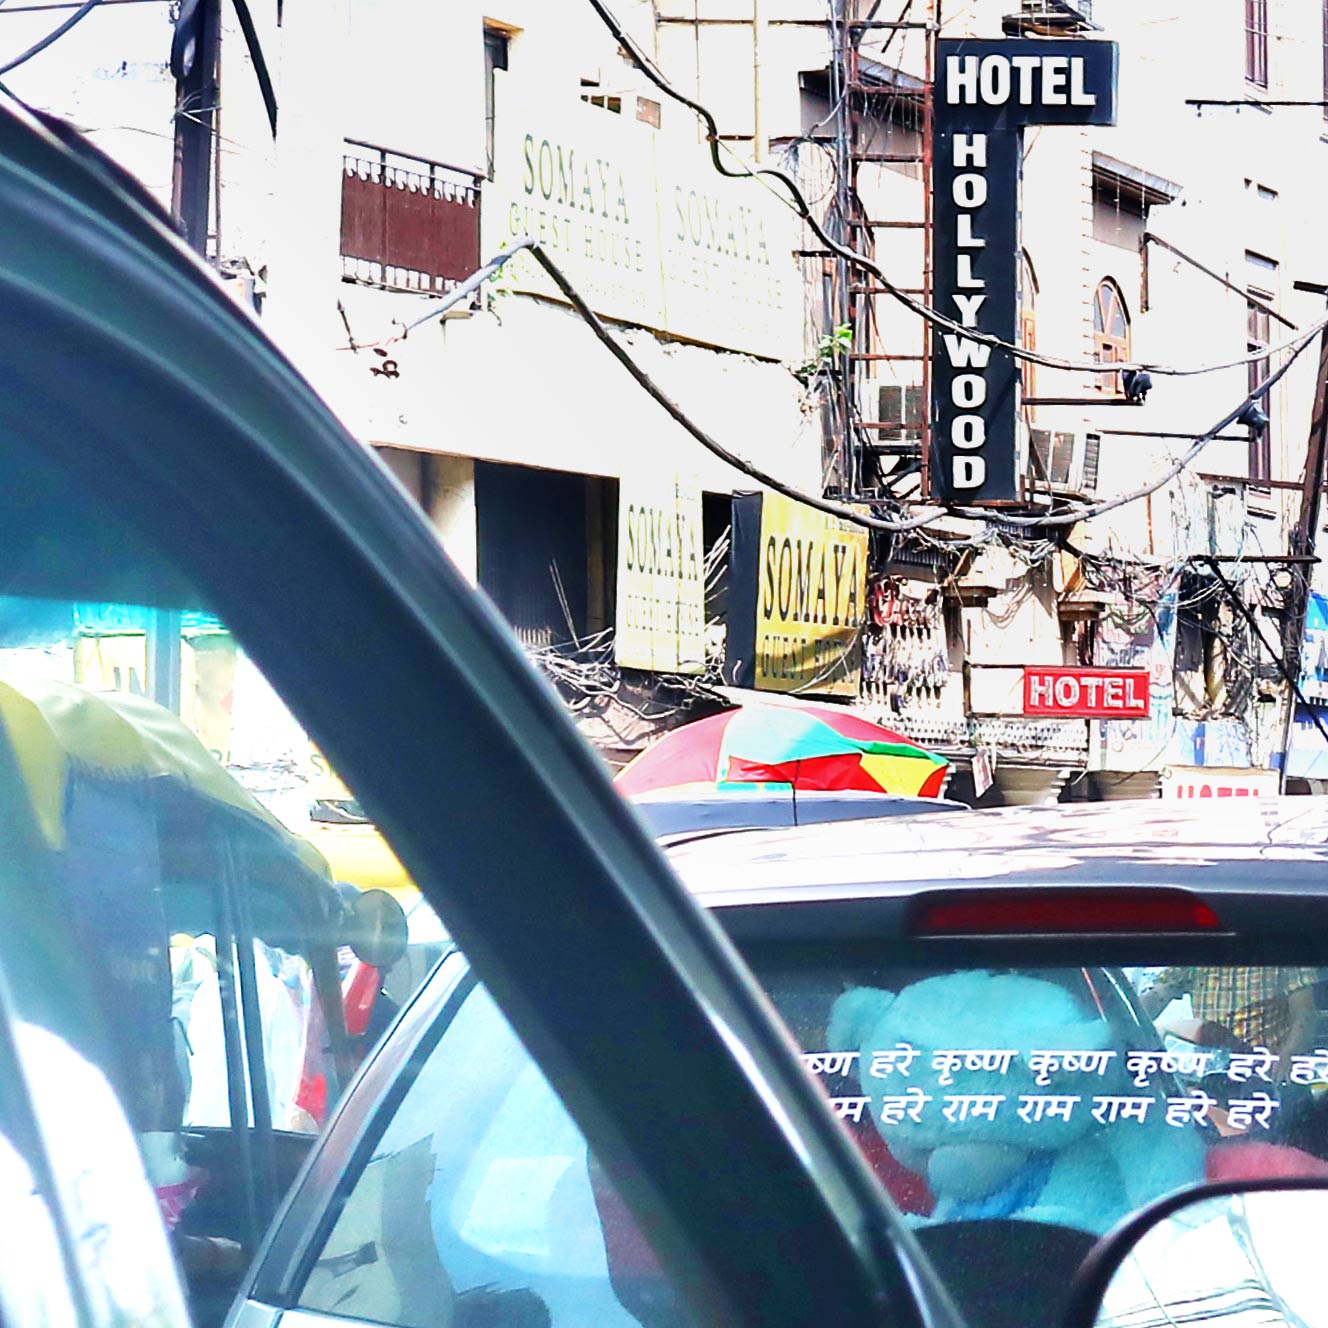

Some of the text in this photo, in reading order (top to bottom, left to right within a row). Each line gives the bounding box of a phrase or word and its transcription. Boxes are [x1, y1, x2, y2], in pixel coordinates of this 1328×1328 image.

[947, 55, 1096, 106] HOTEL
[523, 133, 630, 225] SOMAYA
[941, 133, 991, 489] HOLLYWOOD
[626, 503, 698, 581] SOMAYA
[763, 535, 859, 627] SOMAYA
[1029, 674, 1145, 709] HOTEL
[800, 1050, 861, 1078] ष्ण
[870, 1043, 922, 1078] हरे
[932, 1049, 1018, 1086] कृष्ण
[1029, 1049, 1116, 1087] कृष्ण
[1127, 1049, 1213, 1088] कृष्ण
[1226, 1045, 1280, 1082] हरे
[881, 1089, 933, 1124] हरे
[943, 1095, 1006, 1124] राम
[1017, 1095, 1081, 1124] राम
[1092, 1095, 1156, 1124] राम
[1166, 1091, 1218, 1126] हरे
[1226, 1092, 1280, 1128] हरे
